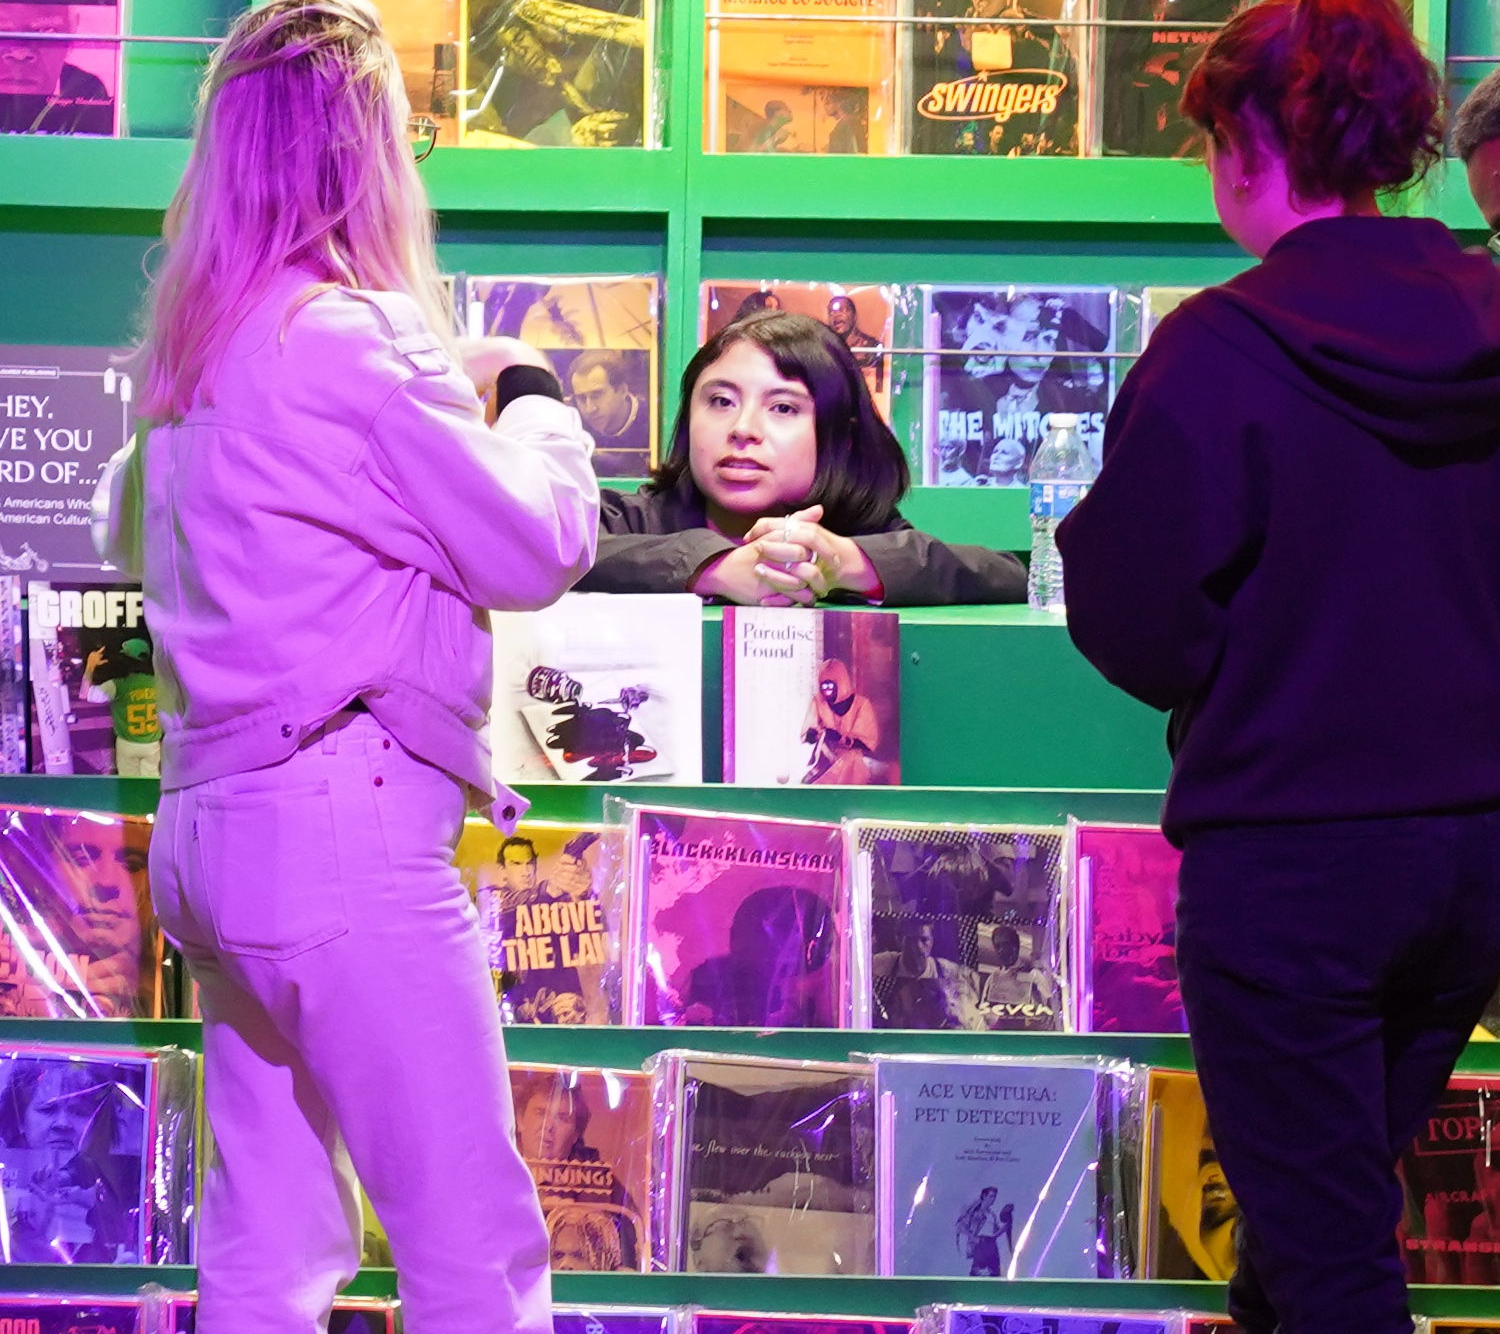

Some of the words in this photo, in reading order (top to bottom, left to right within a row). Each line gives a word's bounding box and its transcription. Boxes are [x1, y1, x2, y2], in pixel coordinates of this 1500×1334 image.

[1151, 31, 1219, 44] NETWO
[938, 410, 984, 441] THE
[992, 410, 1104, 443] WITCES
[33, 428, 93, 452] YOU
[3, 496, 65, 509] Americans
[743, 622, 815, 642] Paradise
[743, 640, 794, 659] Found
[515, 899, 604, 938] ABOVE
[501, 937, 556, 972] THE
[918, 1083, 954, 1100] ACE
[961, 1084, 1058, 1103] VENTURA:
[914, 1107, 950, 1124] PET
[956, 1109, 1063, 1128] DETECTIVE
[1427, 1113, 1480, 1141] TOP
[532, 1167, 614, 1188] NNINGS
